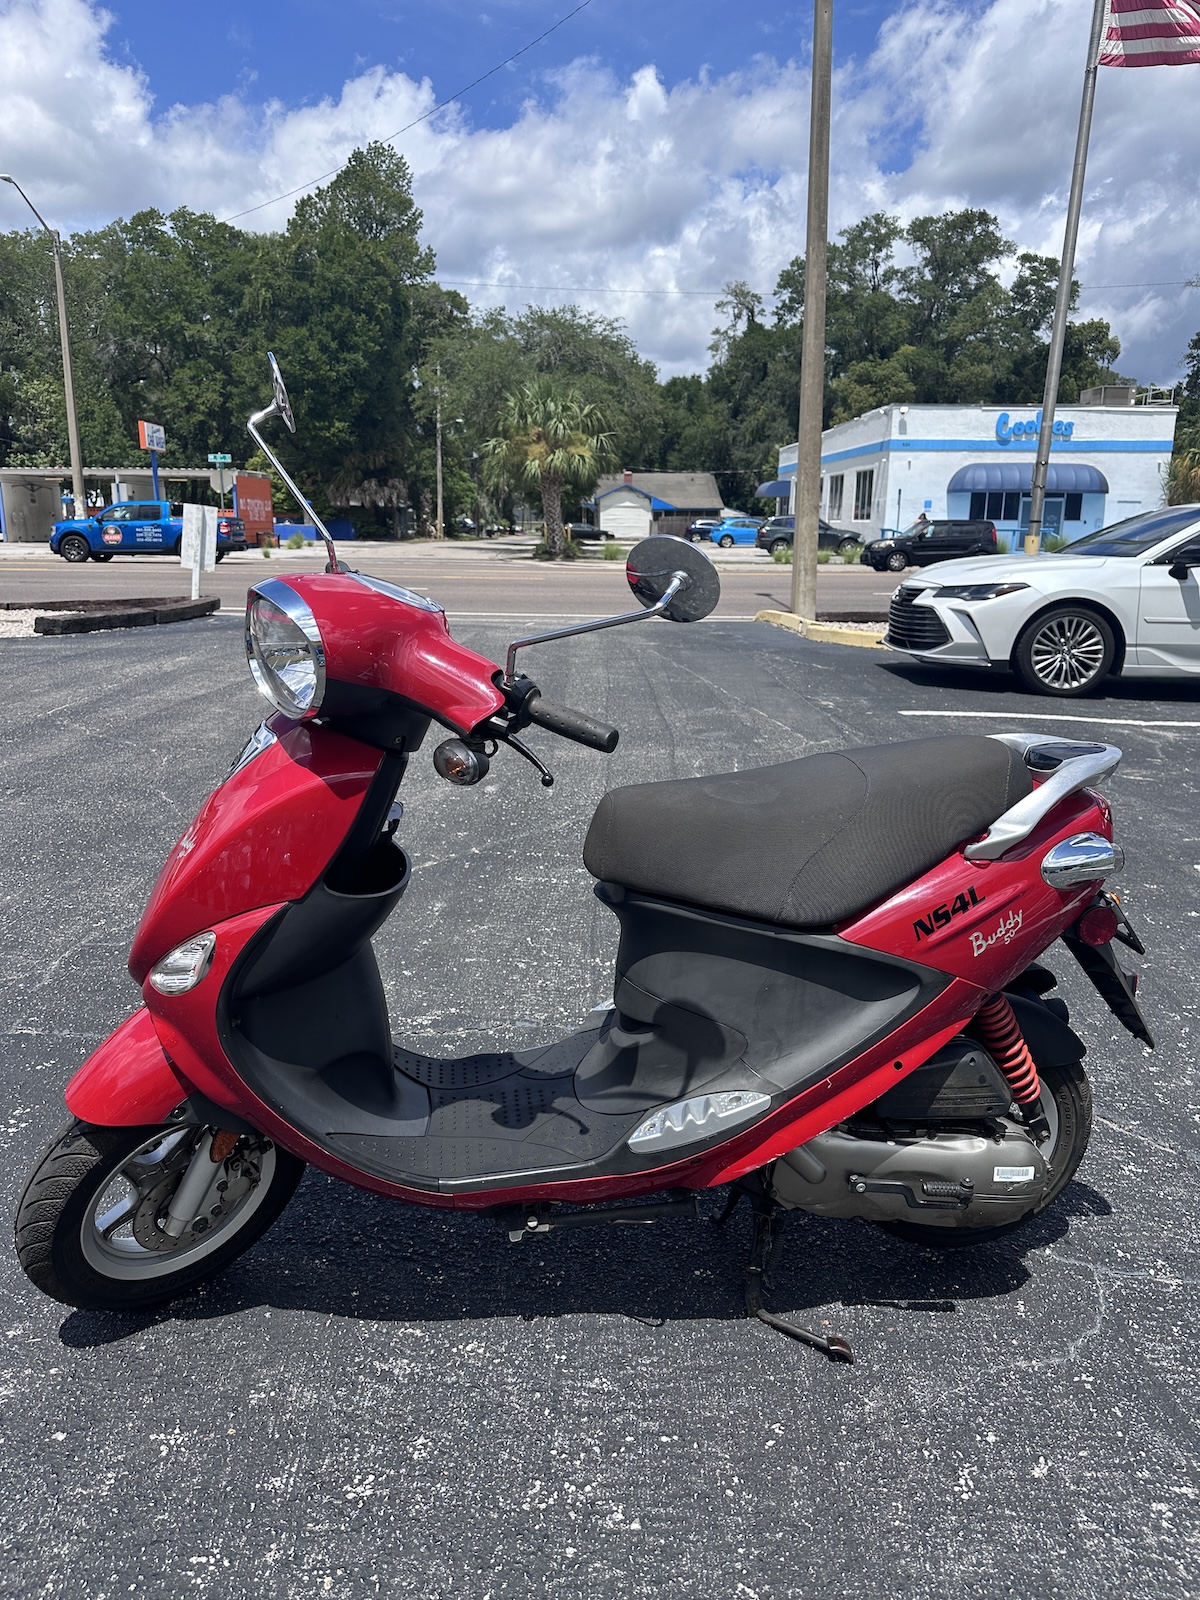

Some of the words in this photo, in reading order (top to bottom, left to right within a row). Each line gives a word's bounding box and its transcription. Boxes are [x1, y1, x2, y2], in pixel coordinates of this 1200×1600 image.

[996, 410, 1074, 438] Cooes
[912, 886, 986, 942] NS4L
[968, 909, 1023, 957] Buddy
[1004, 929, 1015, 945] 50
